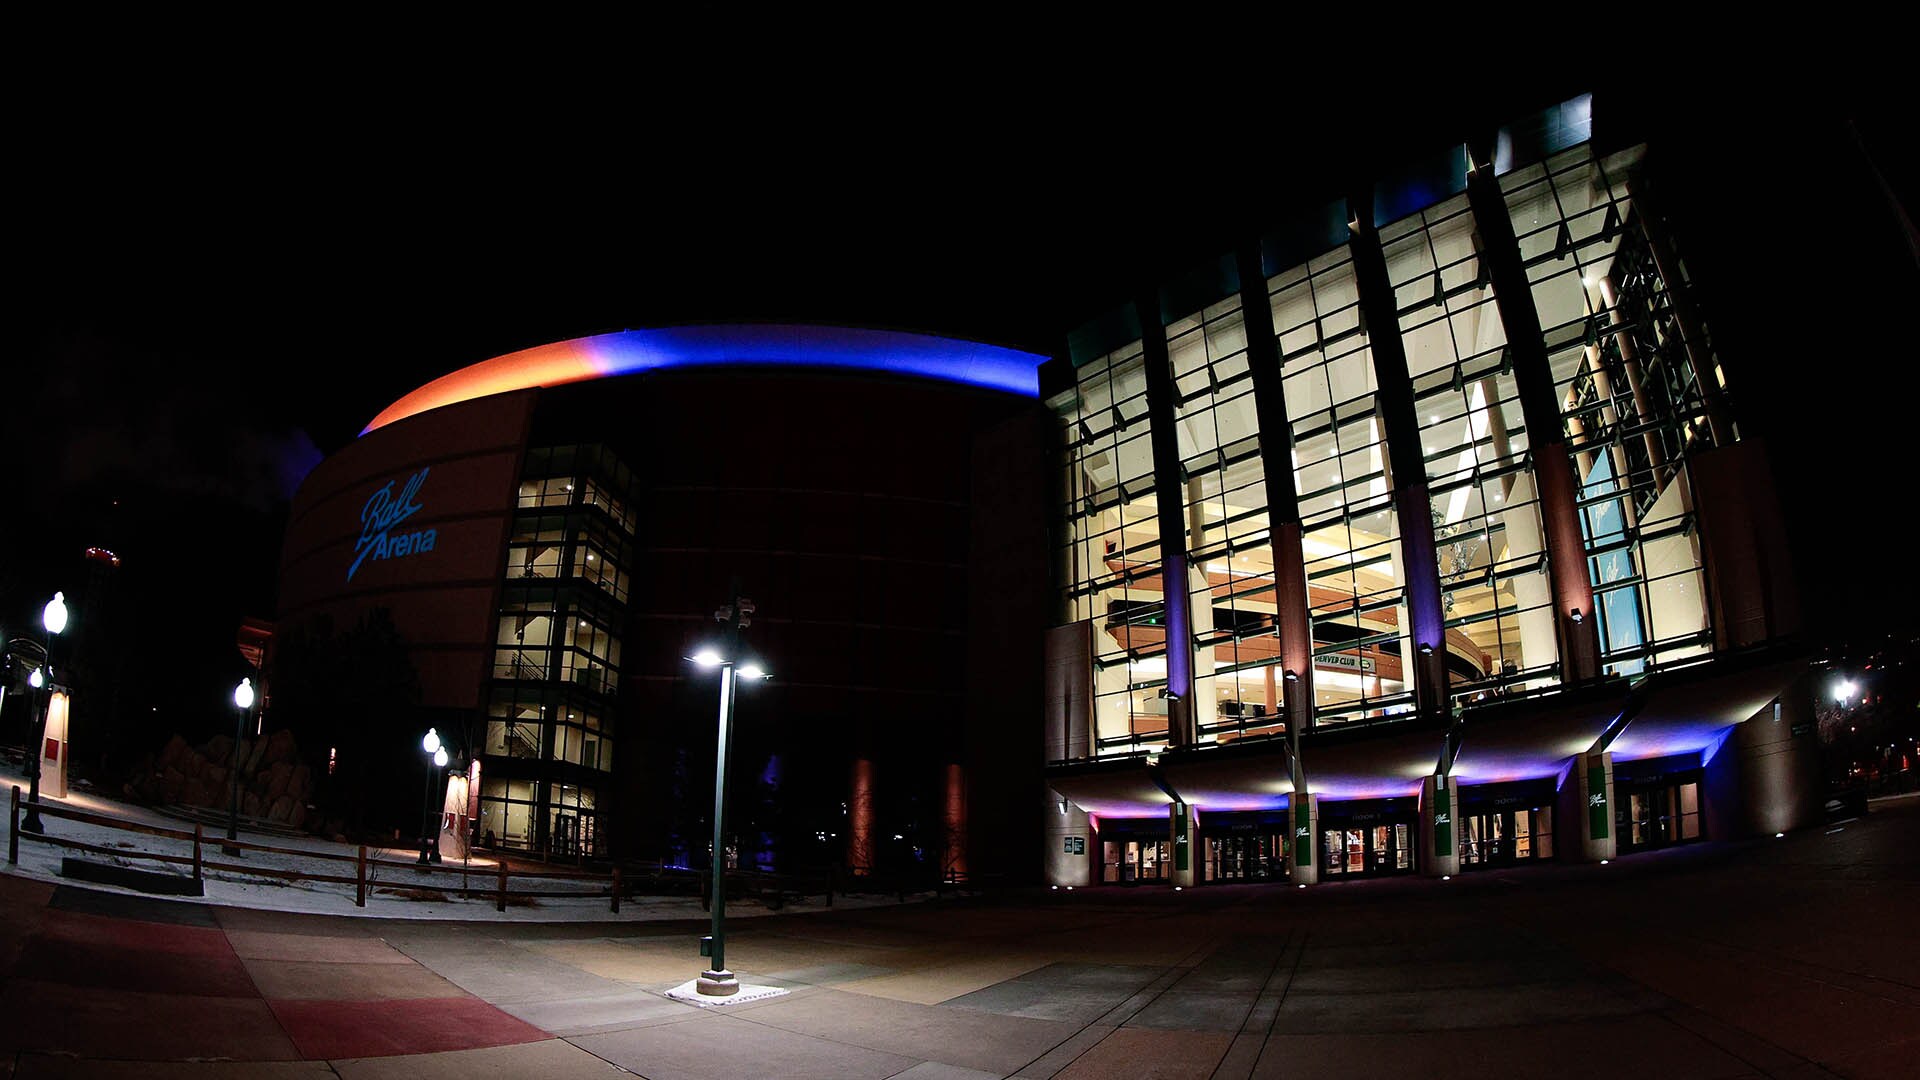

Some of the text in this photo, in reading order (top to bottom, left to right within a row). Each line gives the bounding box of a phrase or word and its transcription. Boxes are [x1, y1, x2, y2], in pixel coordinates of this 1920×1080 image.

[351, 464, 430, 554] Ball
[371, 528, 438, 560] Arena
[1340, 657, 1355, 666] CLUB
